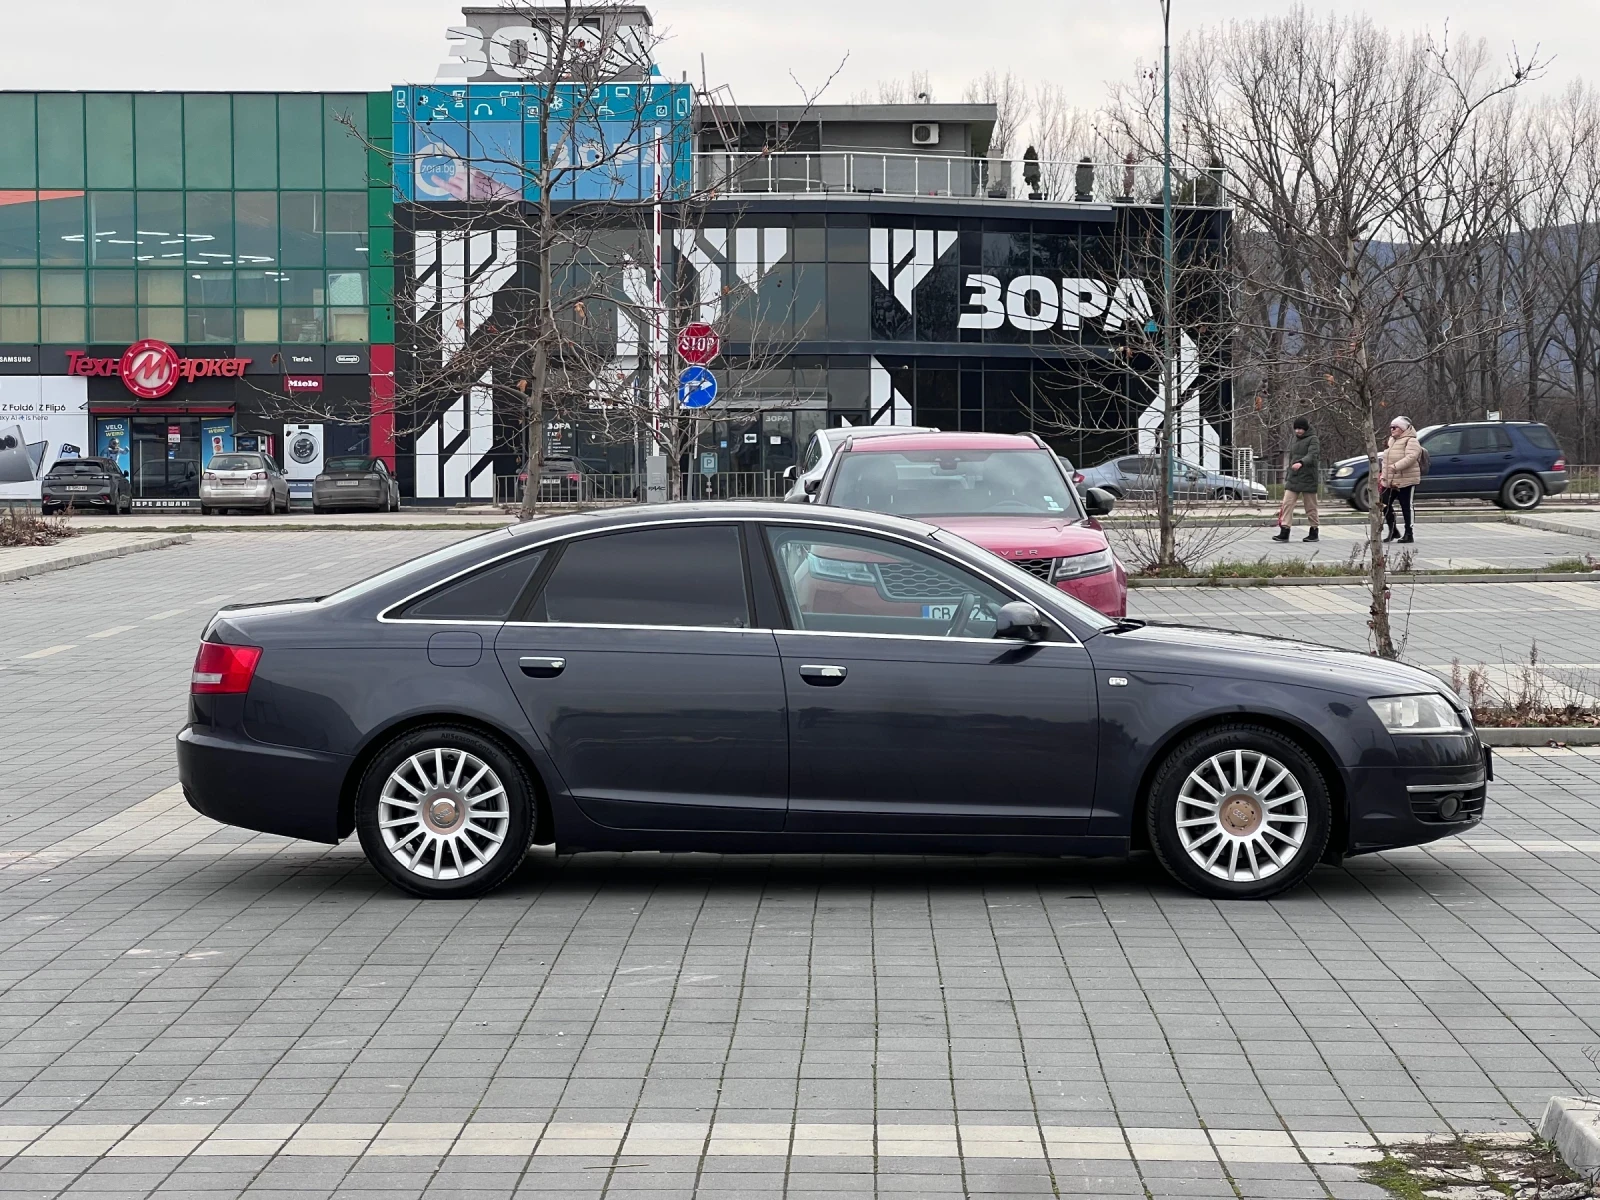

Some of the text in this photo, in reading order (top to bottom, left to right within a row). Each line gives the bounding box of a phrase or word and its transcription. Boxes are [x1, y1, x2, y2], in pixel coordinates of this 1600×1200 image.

[421, 164, 455, 175] zora.bg
[956, 274, 1156, 332] ЗОРА
[681, 337, 716, 352] STOP
[46, 404, 66, 413] Flip6
[441, 733, 498, 759] AllSeasonContact
